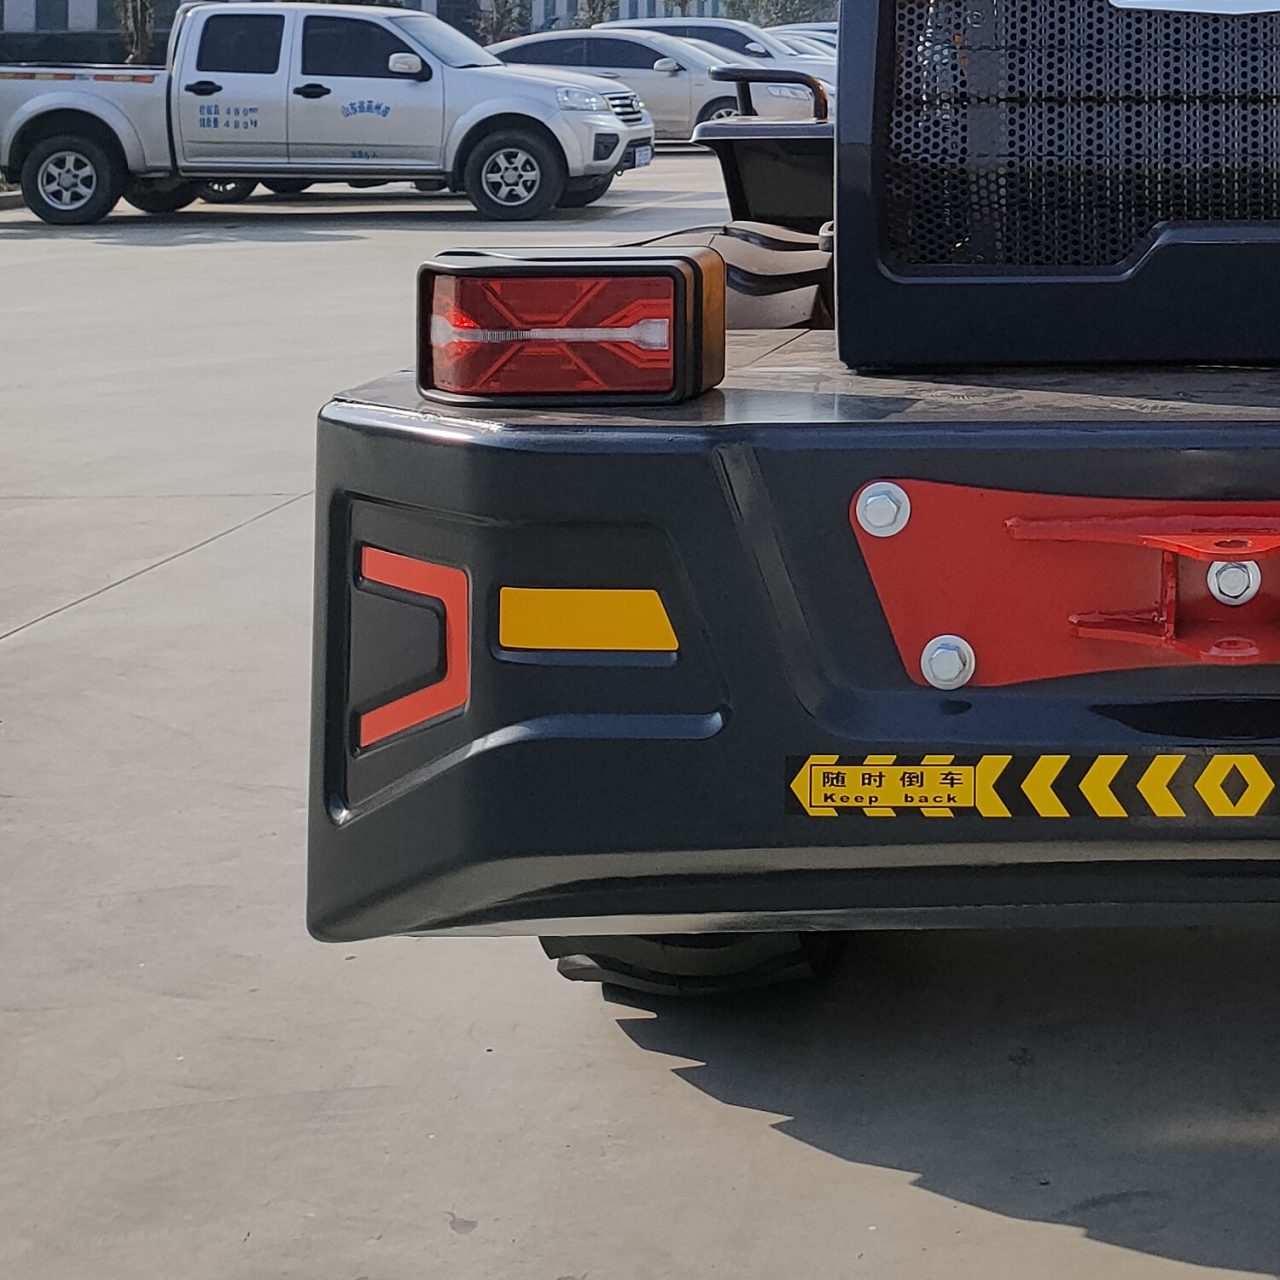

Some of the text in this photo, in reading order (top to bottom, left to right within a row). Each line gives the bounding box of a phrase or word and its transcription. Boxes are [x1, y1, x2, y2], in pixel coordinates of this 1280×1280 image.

[822, 770, 964, 789] 随时倒车
[823, 793, 958, 804] Keep back
